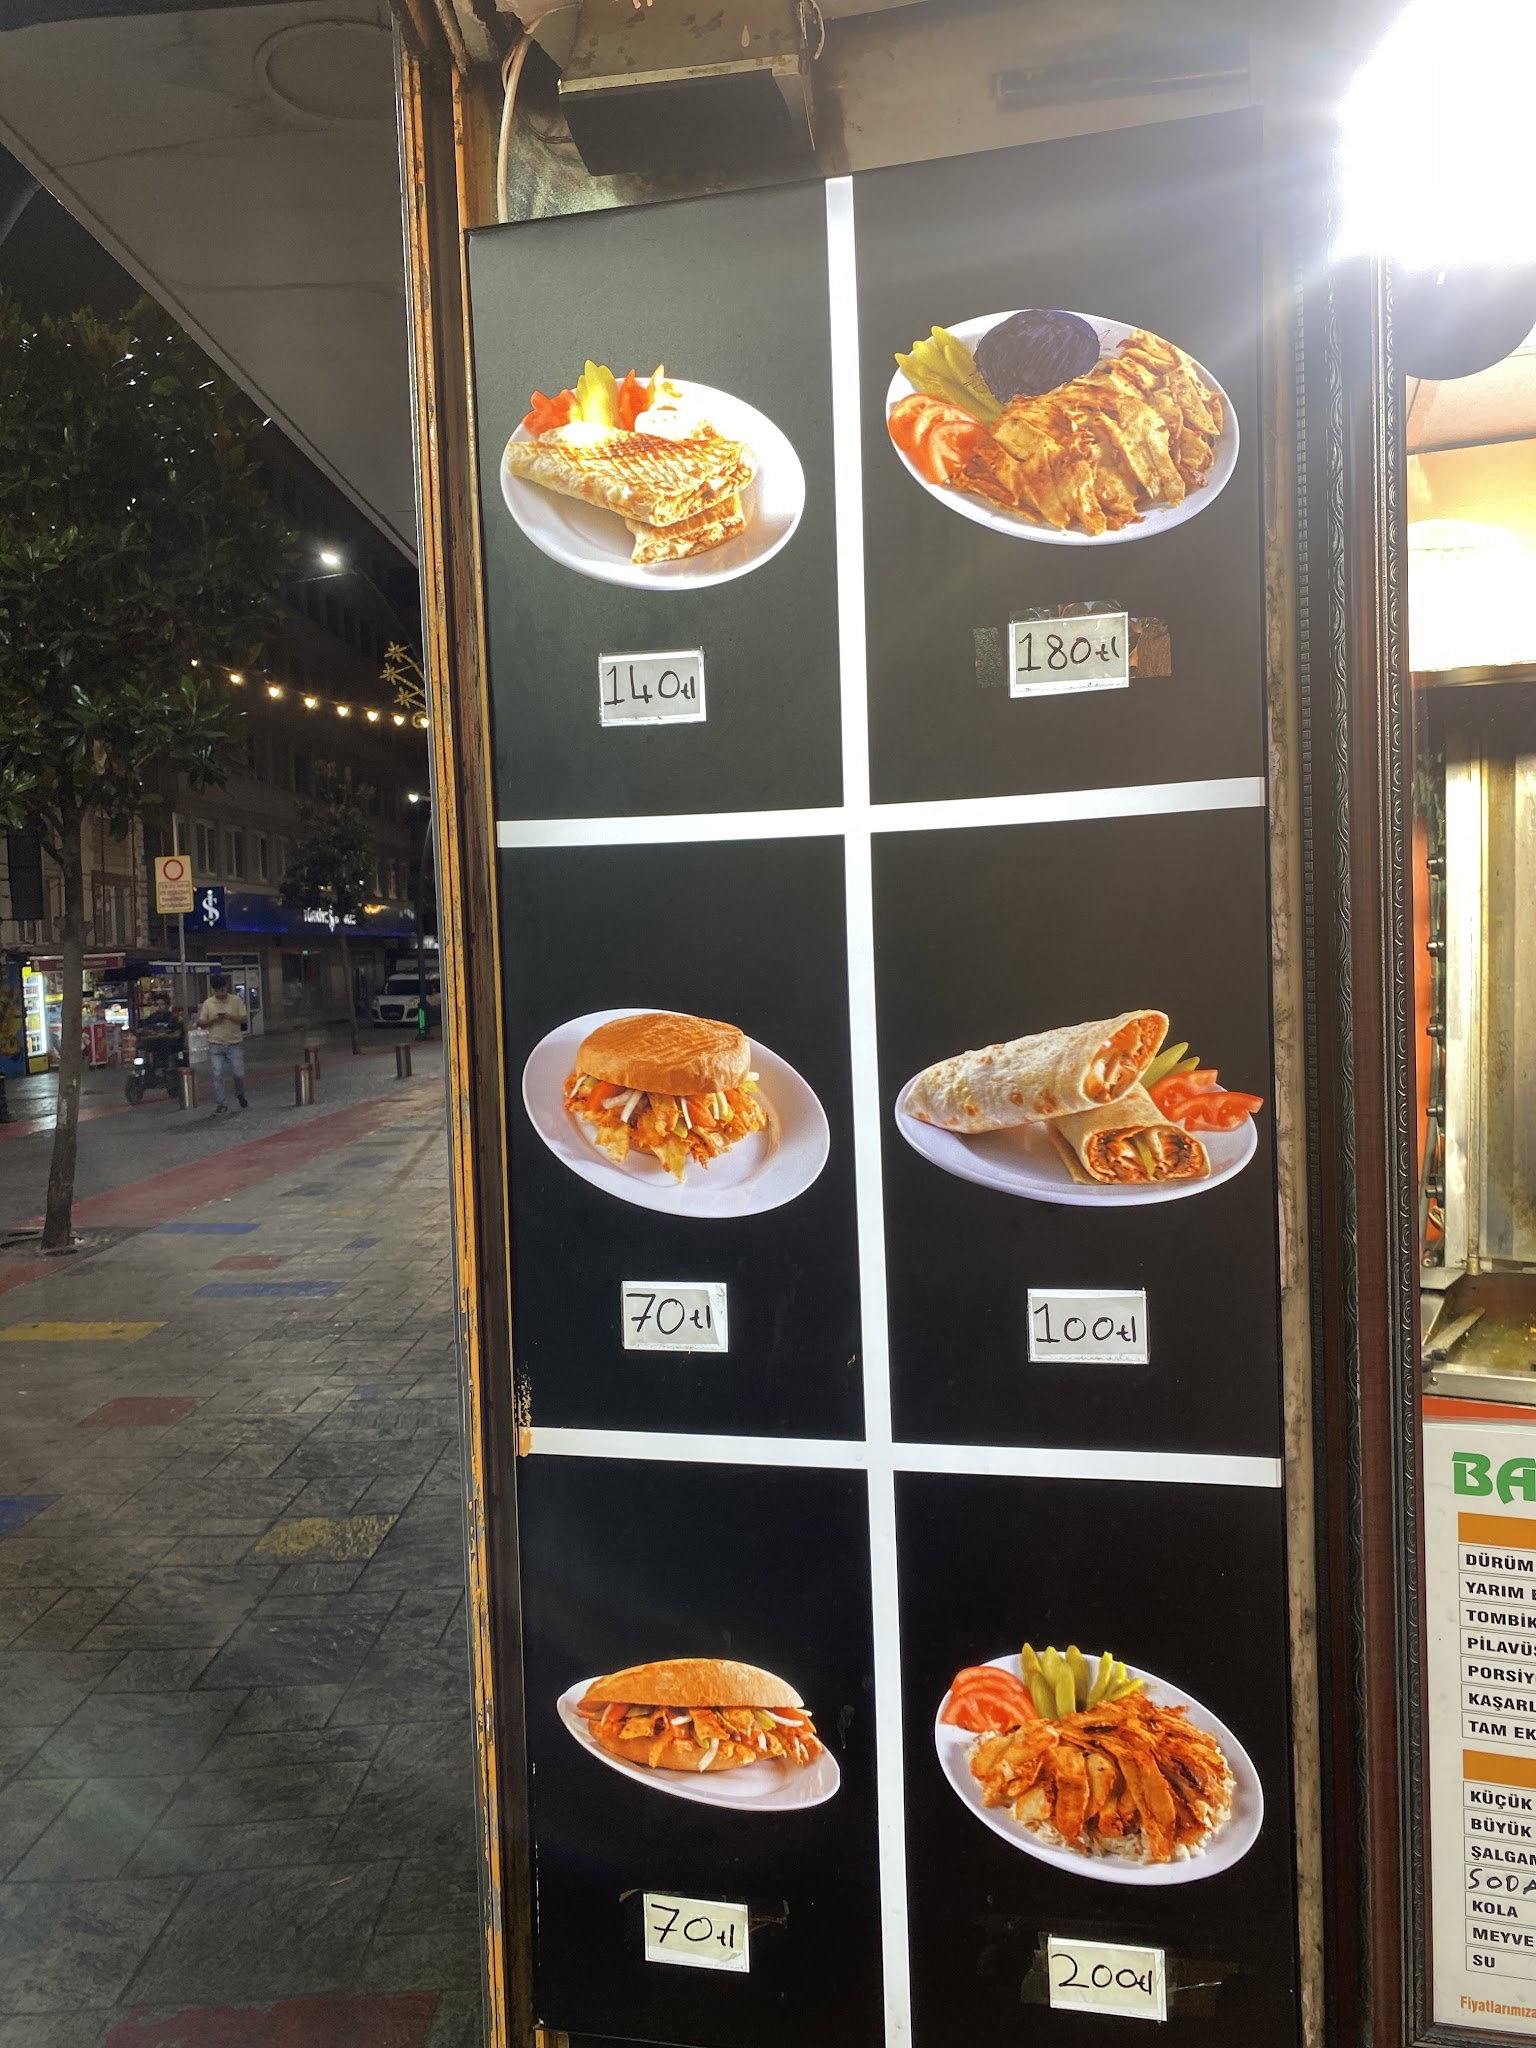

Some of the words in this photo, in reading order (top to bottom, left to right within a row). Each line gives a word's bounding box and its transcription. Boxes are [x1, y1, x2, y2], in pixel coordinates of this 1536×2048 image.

[626, 1292, 712, 1335] 70tl
[1034, 1303, 1137, 1343] 100tl
[1466, 1552, 1533, 1572] DÜRÜM
[1465, 1581, 1524, 1599] YARIM
[1466, 1609, 1536, 1629] TOMBİK
[1467, 1636, 1536, 1657] PİLAVÜ
[1468, 1665, 1536, 1684] PORSİY
[1469, 1692, 1536, 1712] KAŞARL
[1468, 1720, 1507, 1737] TAM
[1514, 1726, 1536, 1741] EK
[1470, 1789, 1533, 1811] KÜÇÜK
[1471, 1817, 1532, 1838] BÜYÜK
[1468, 1868, 1536, 1895] SODA
[1472, 1900, 1518, 1918] KOLA
[651, 1903, 735, 1948] 70tl
[1472, 1927, 1534, 1947] MEYVE
[1472, 1954, 1496, 1968] SU
